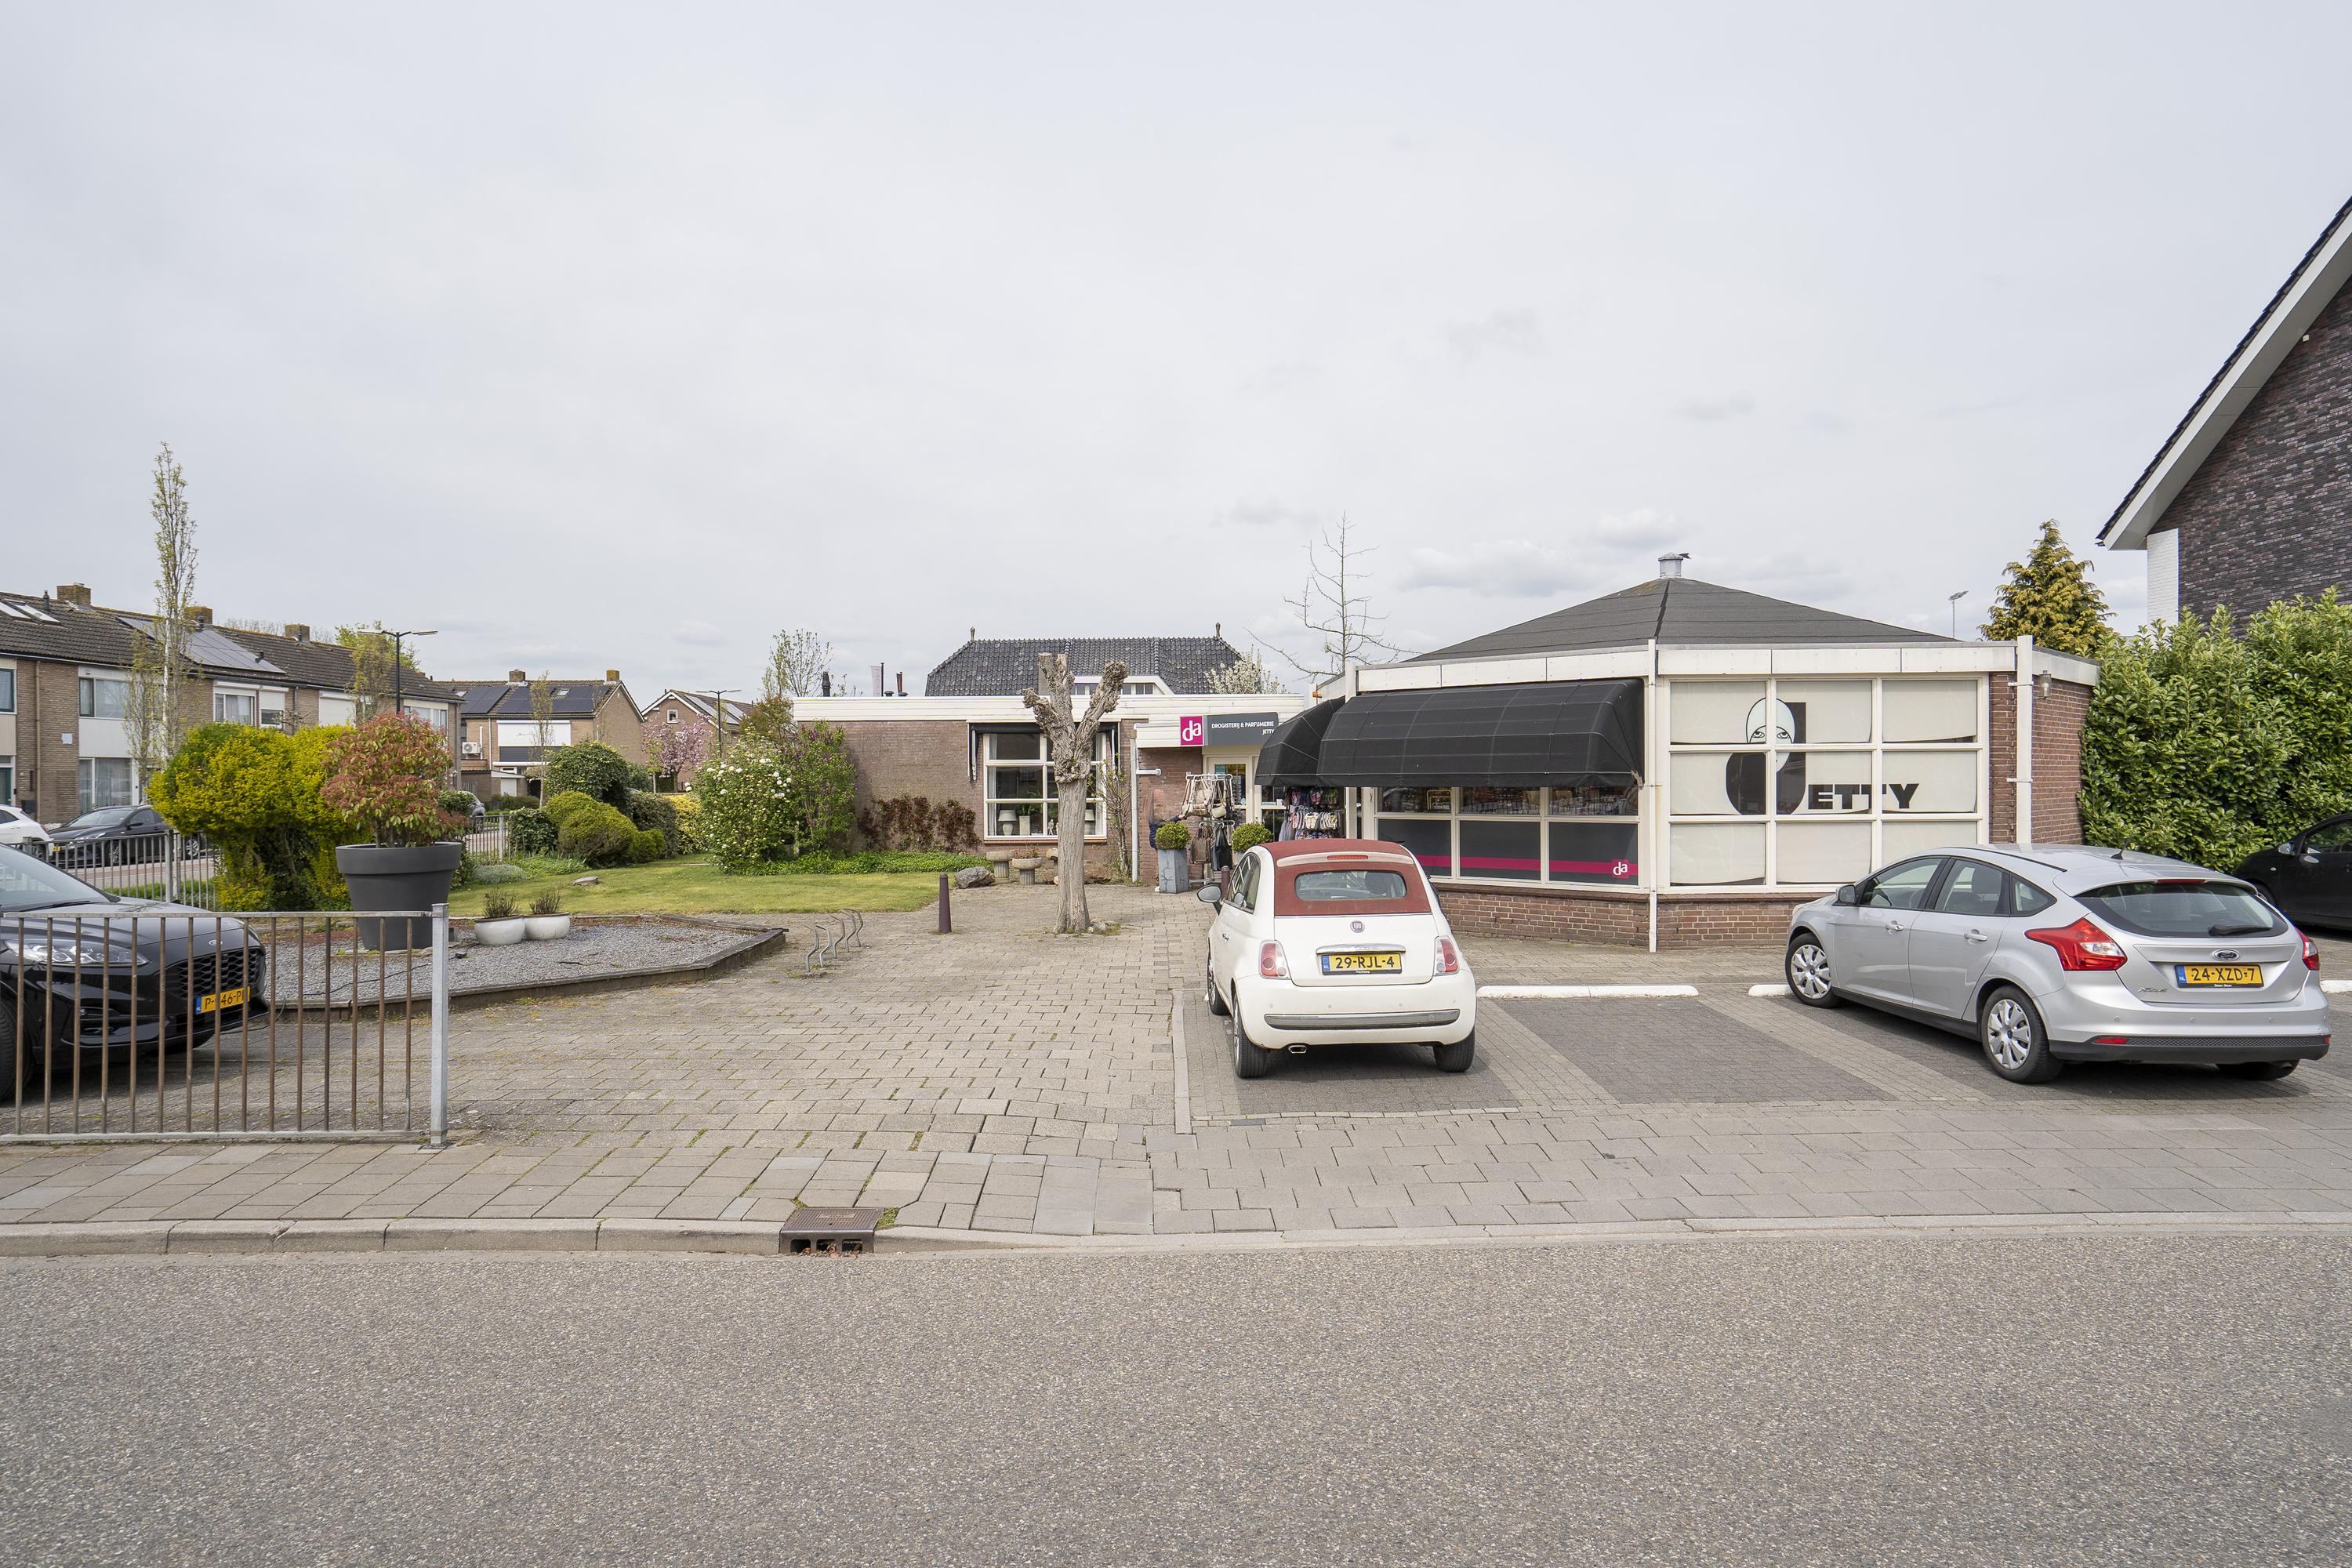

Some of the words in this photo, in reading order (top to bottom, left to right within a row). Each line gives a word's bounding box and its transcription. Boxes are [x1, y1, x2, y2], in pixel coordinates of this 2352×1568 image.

[1182, 720, 1202, 741] da
[1613, 862, 1628, 876] da
[1335, 956, 1394, 969] 29-RJL-4
[2191, 968, 2255, 982] 24-XZD-7
[205, 990, 248, 1010] P-46-P
